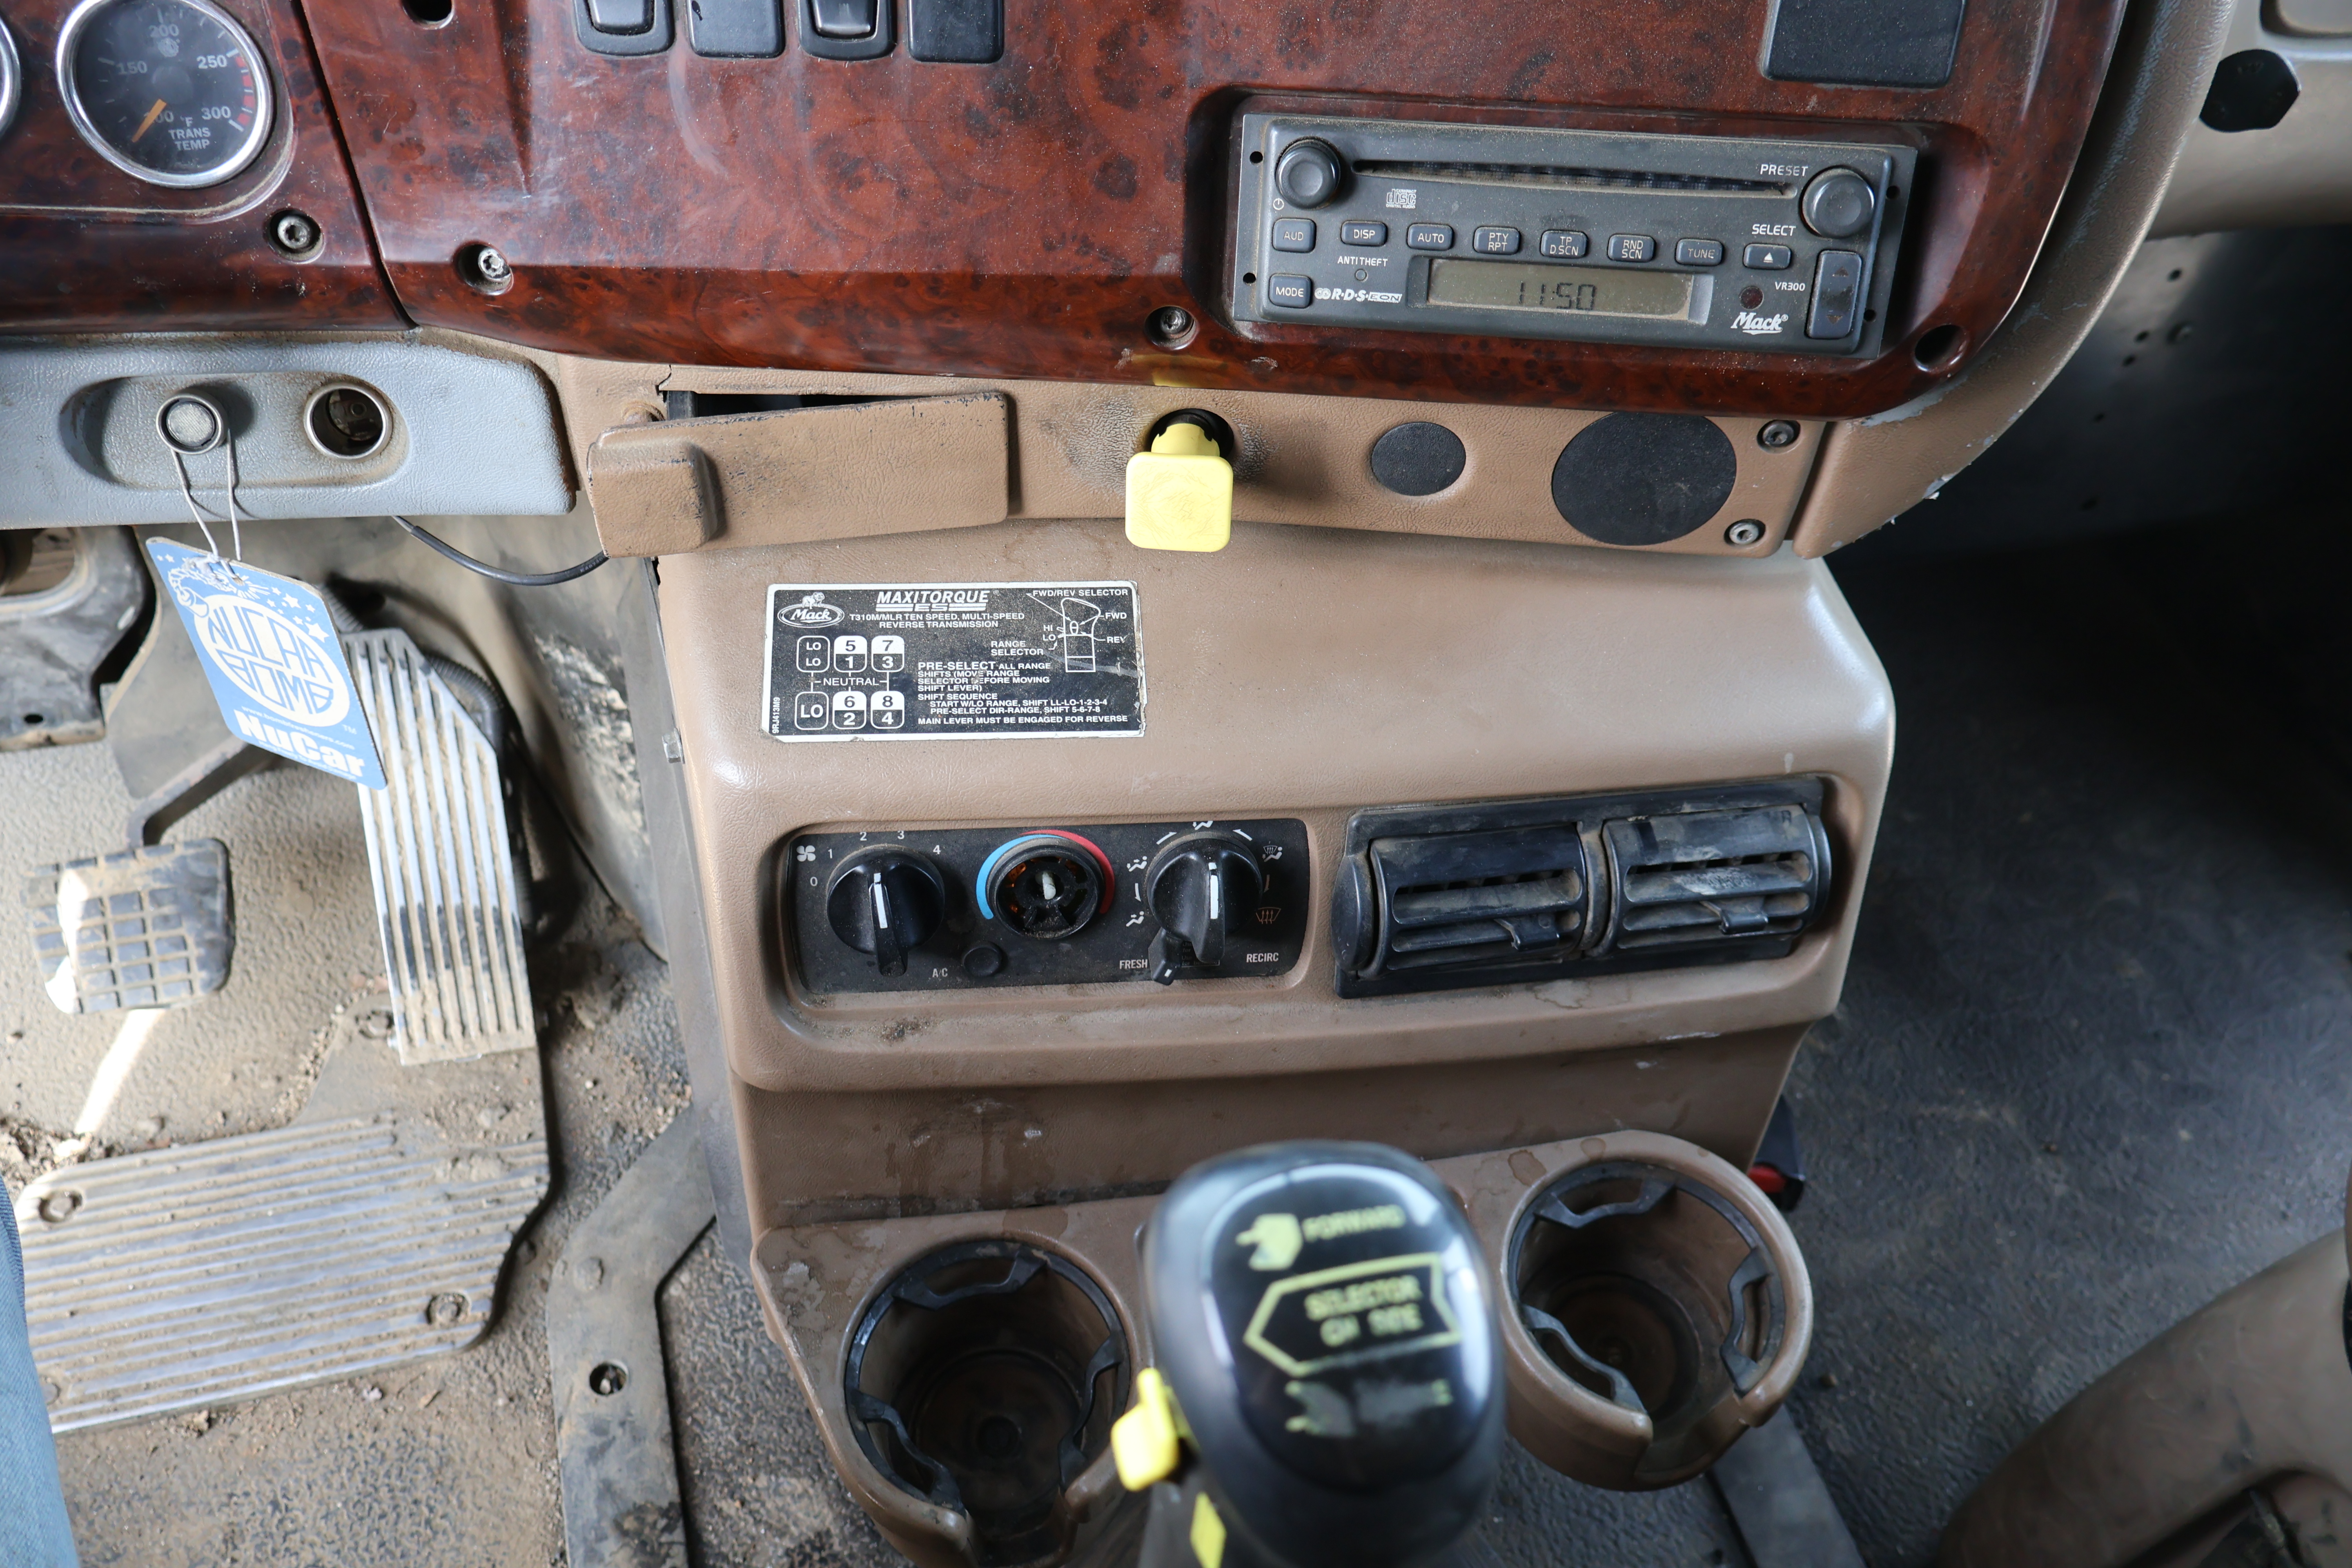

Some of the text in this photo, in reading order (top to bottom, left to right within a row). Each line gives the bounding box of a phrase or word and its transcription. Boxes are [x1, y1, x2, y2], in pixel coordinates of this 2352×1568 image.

[149, 24, 179, 38] 200
[197, 55, 227, 69] 250
[117, 61, 147, 74] 150
[201, 106, 231, 120] 300
[169, 127, 211, 140] TRANS
[175, 139, 210, 151] TEMP
[1760, 164, 1808, 176] PRESET
[1353, 229, 1376, 240] DISP
[1751, 224, 1796, 236] SELECT
[1283, 232, 1304, 241] AUD
[1417, 233, 1445, 243] AUTO
[1490, 232, 1509, 242] PTY
[1559, 236, 1572, 245] TP
[1488, 242, 1508, 252] RPT
[1623, 240, 1643, 250] RND
[1621, 250, 1642, 260] SCN
[1688, 249, 1715, 259] TUNE
[1775, 282, 1806, 291] VR300
[1276, 288, 1304, 298] MODE
[1519, 281, 1596, 310] 11:50
[915, 603, 948, 612] ES
[790, 609, 832, 621] Mack
[926, 613, 960, 621] SPEED,
[806, 642, 822, 650] LO
[845, 640, 856, 652] 5
[882, 640, 893, 652] 7
[806, 658, 821, 666] LO
[845, 657, 853, 668] 1
[882, 657, 894, 668] 3
[918, 661, 996, 670] PRE-SELECT
[215, 648, 334, 715] BOMB
[823, 677, 879, 686] NEUTRAL
[844, 695, 855, 708] 6
[882, 695, 893, 708] 8
[772, 697, 780, 733] 9RJ413M9
[800, 704, 823, 718] LO
[843, 712, 855, 725] 2
[882, 712, 893, 724] 4
[233, 709, 365, 777] NuCar
[860, 831, 867, 841] 2
[897, 830, 905, 840] 3
[828, 849, 833, 859] 1
[933, 845, 941, 855] 4
[810, 877, 818, 886] 0
[1246, 953, 1279, 963] RECIRC
[1119, 959, 1148, 969] FRESH
[932, 968, 948, 978] A/C
